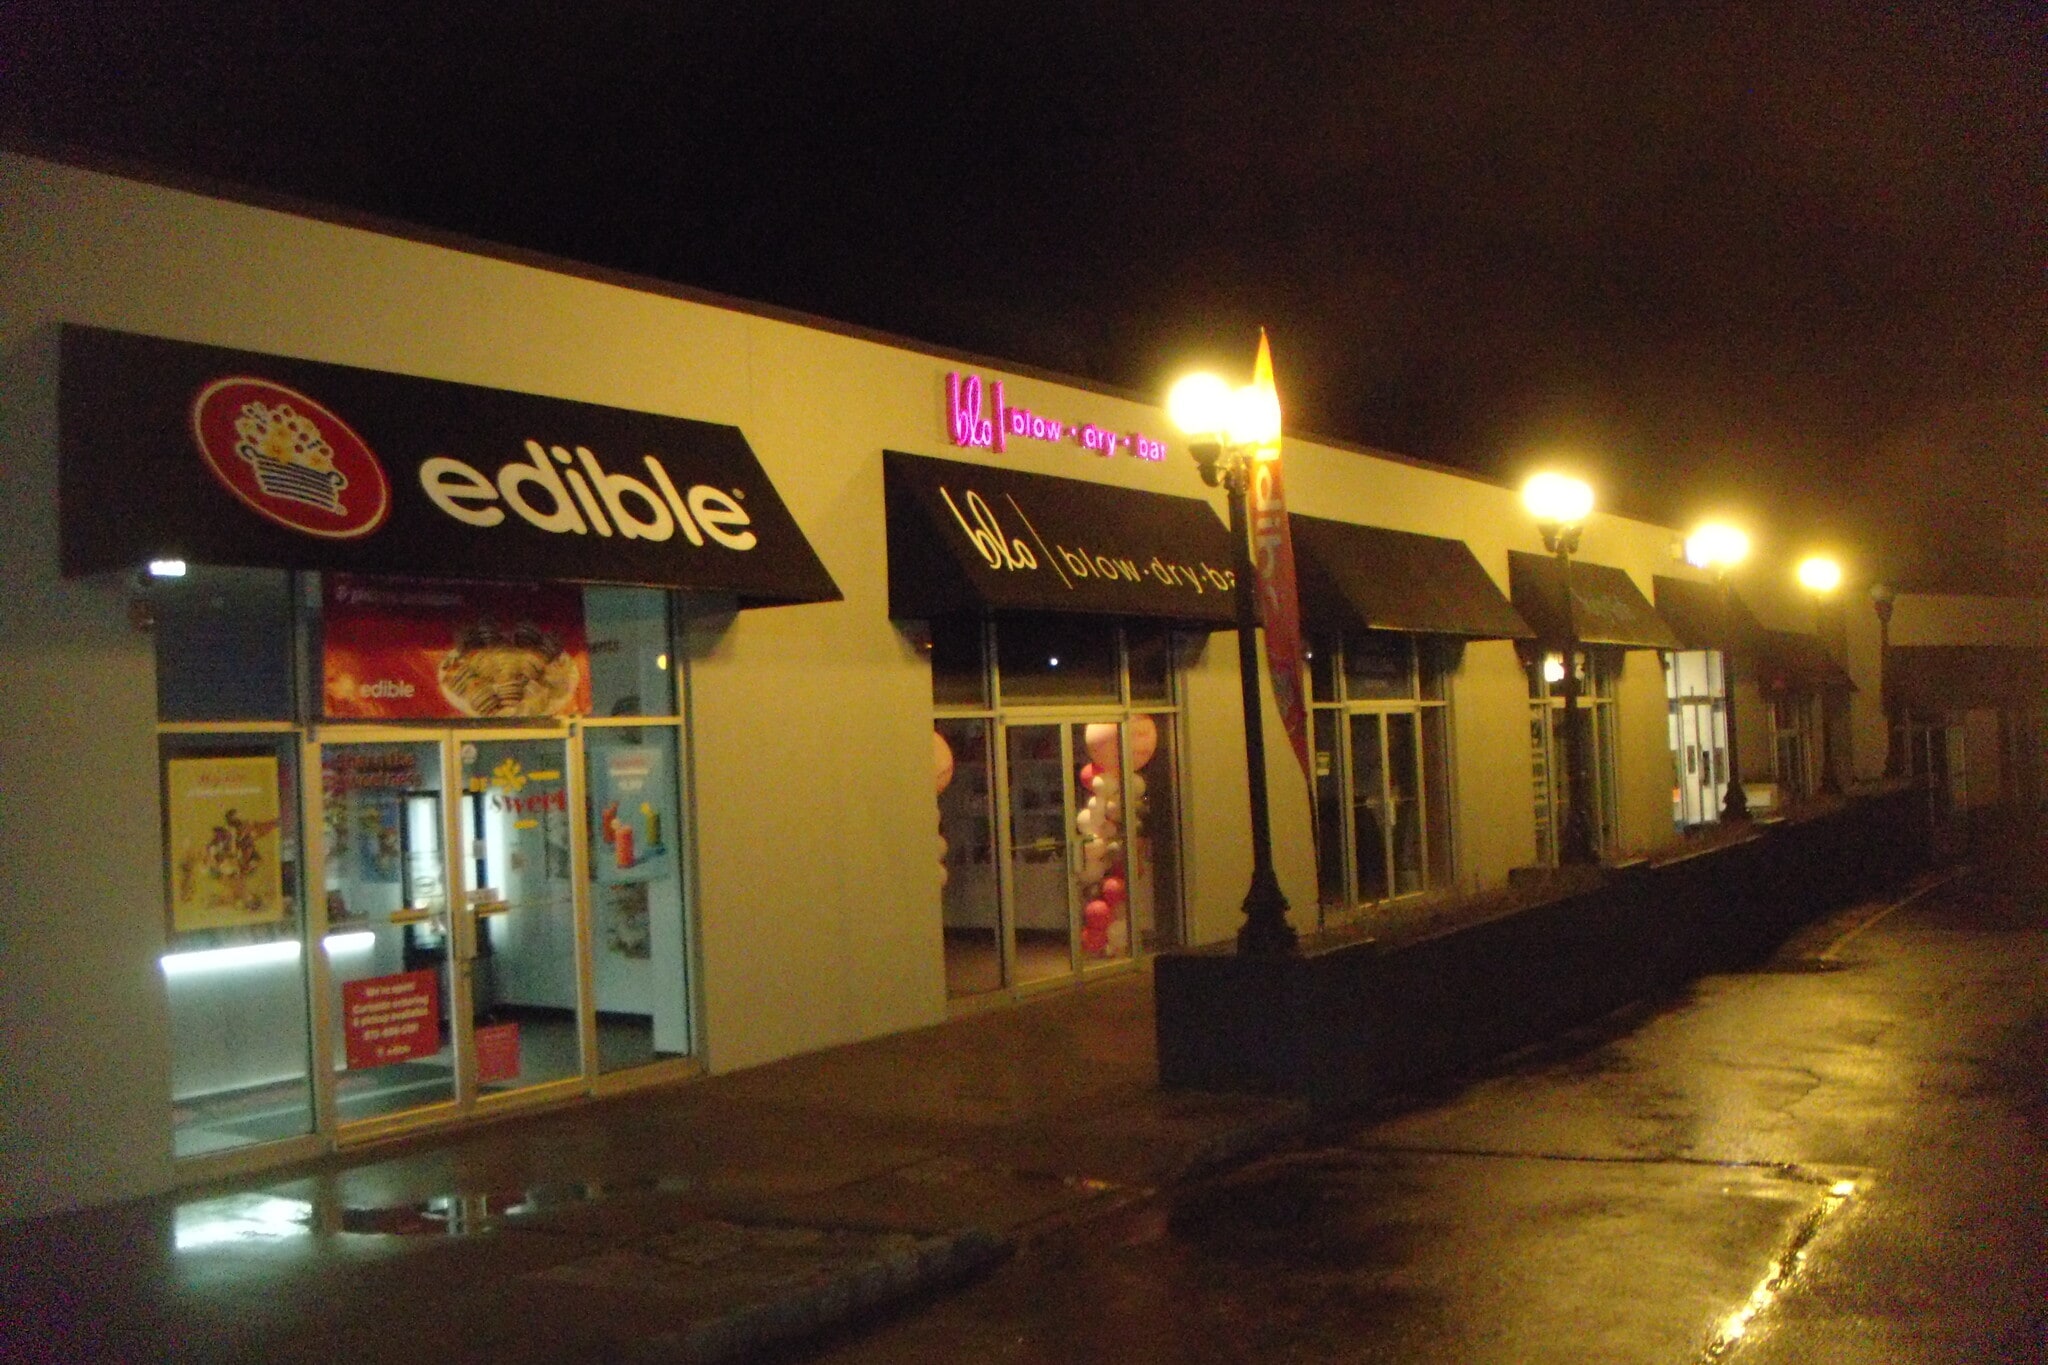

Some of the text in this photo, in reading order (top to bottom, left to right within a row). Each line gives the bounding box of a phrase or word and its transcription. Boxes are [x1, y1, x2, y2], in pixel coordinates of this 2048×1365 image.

[946, 370, 1168, 461] blo blow dry bar
[418, 439, 757, 551] edible
[1200, 562, 1236, 591] ba
[359, 679, 416, 698] edible
